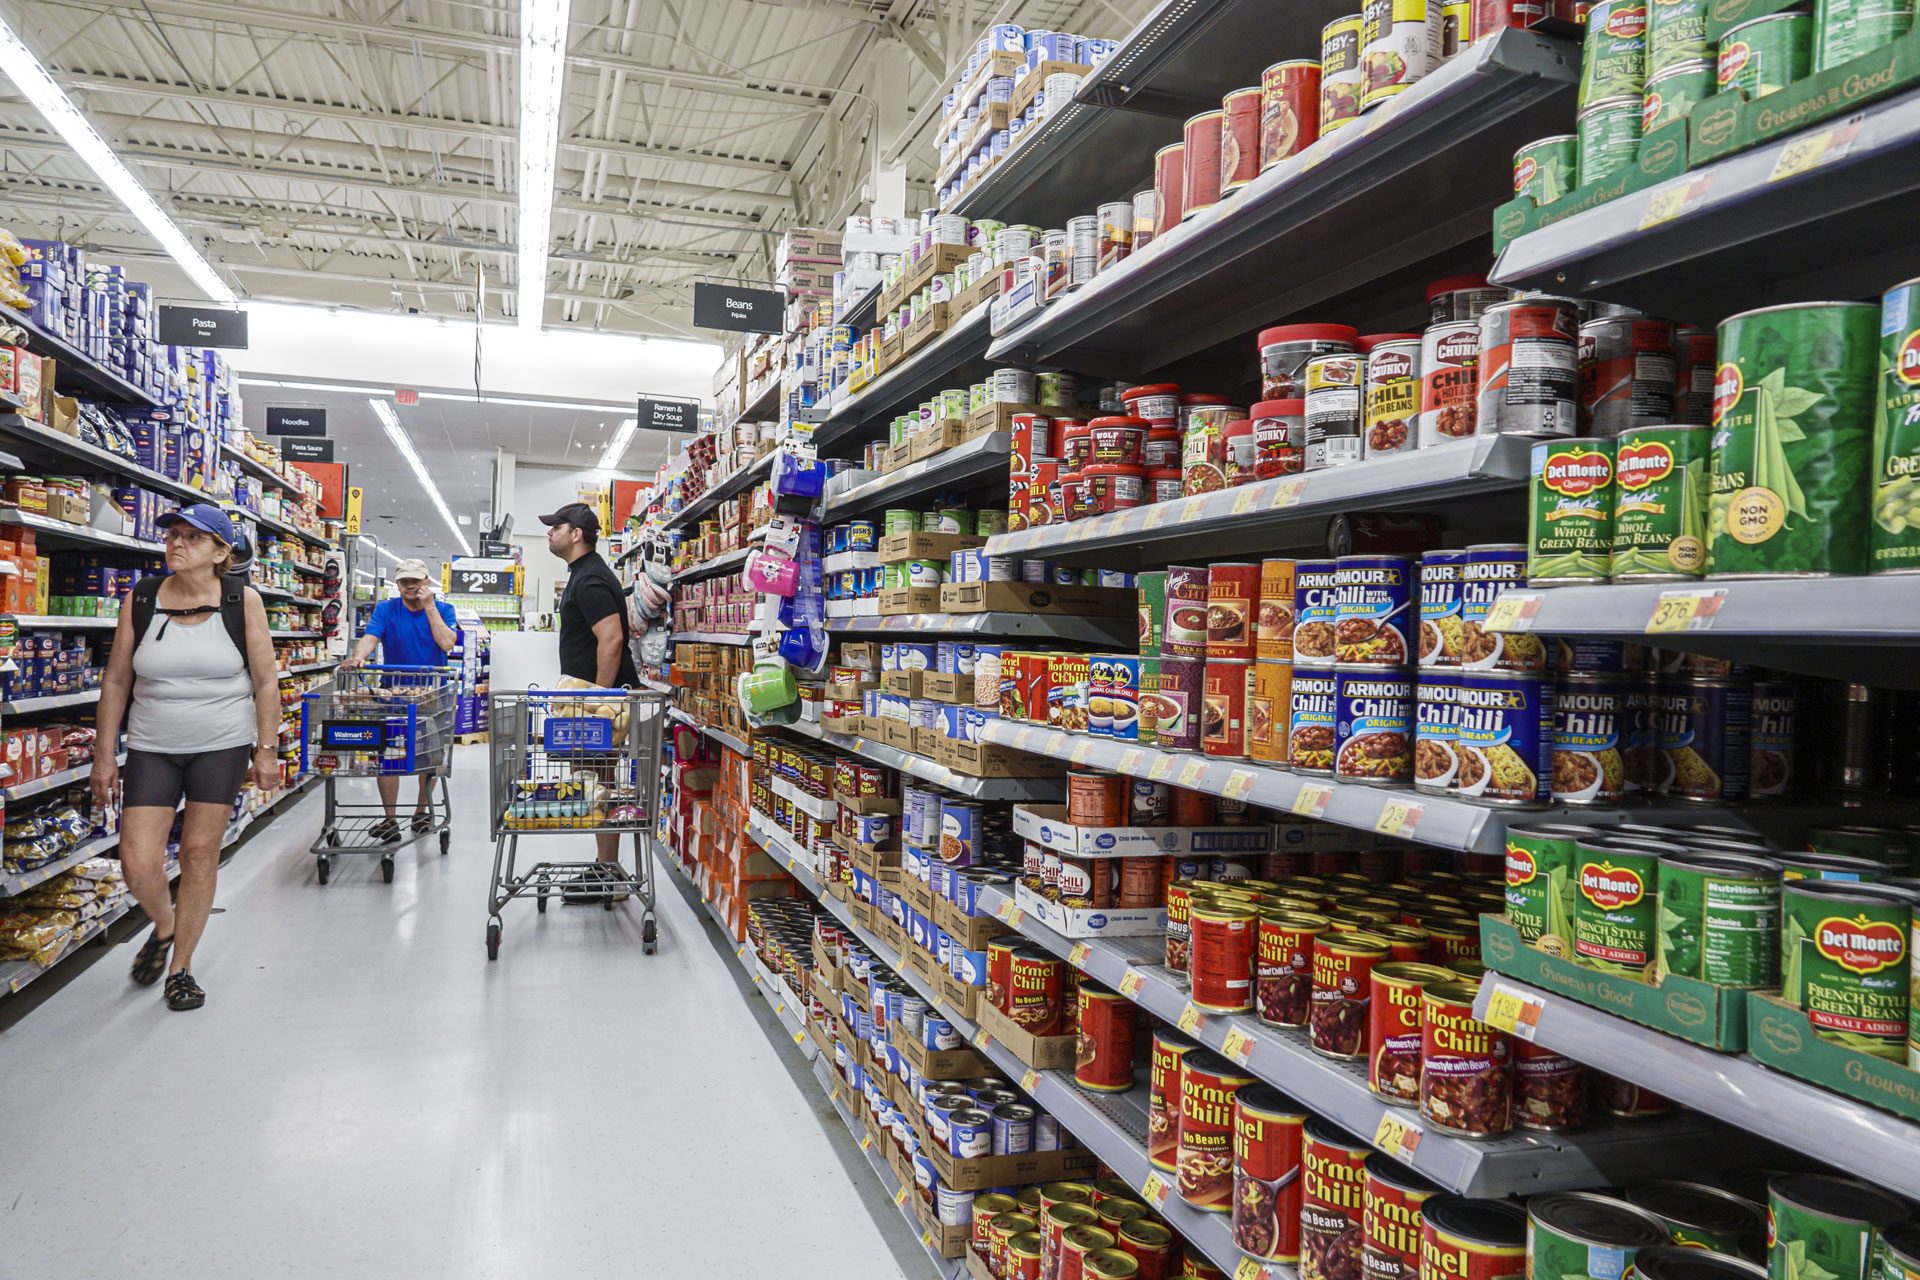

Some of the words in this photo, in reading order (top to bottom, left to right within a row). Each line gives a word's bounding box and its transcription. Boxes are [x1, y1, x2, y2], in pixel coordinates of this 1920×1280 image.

[1626, 15, 1647, 26] Mon
[1596, 57, 1632, 69] FRENCH
[1596, 67, 1626, 79] GREEN
[1626, 62, 1646, 74] BEA
[1757, 95, 1827, 131] Growers
[1843, 56, 1897, 98] Good
[1592, 180, 1626, 206] Good
[726, 298, 753, 310] Beans
[192, 318, 216, 328] Pasta
[1372, 363, 1410, 377] CHUNKY
[1368, 384, 1413, 405] CHILI
[654, 404, 676, 412] Ramen
[1386, 400, 1413, 412] BEANS
[282, 418, 310, 426] Noodles
[654, 412, 664, 420] Dry
[666, 413, 682, 422] Soup
[1096, 432, 1118, 440] WOLF
[1256, 428, 1286, 442] CHUNKY
[292, 444, 306, 452] Pasta
[306, 444, 323, 452] Sauce
[1618, 460, 1629, 473] Del
[1630, 454, 1668, 470] Monte
[1548, 465, 1566, 478] Del
[1568, 464, 1608, 478] Monte
[1563, 480, 1590, 488] Quality
[1740, 506, 1768, 515] NON
[1618, 522, 1653, 533] WHOLE
[1740, 516, 1768, 526] GMO
[349, 525, 358, 533] 15
[852, 527, 872, 536] BUSH'S
[1554, 526, 1596, 538] WHOLE
[1539, 538, 1574, 550] GREEN
[1576, 538, 1613, 549] BEANS
[1634, 532, 1672, 544] BEANS
[1168, 572, 1190, 590] Amy's
[1298, 574, 1336, 587] ARMO
[1366, 596, 1392, 604] BEANS
[1422, 584, 1454, 603] hili
[1340, 605, 1376, 614] ORIGINAL
[1292, 680, 1334, 693] ARMOU
[1346, 683, 1411, 697] ARMOUR
[1292, 694, 1327, 712] Chili
[1350, 698, 1398, 717] Chili
[1300, 714, 1333, 722] ORIGINA
[1366, 718, 1407, 727] ORIGINAL
[1463, 708, 1504, 731] hili
[1554, 712, 1614, 735] Chili
[1430, 726, 1460, 734] BEANS
[1467, 731, 1496, 741] BEANS
[1572, 736, 1608, 744] BEANS
[1059, 874, 1084, 888] CHILI
[1583, 873, 1598, 888] Del
[1600, 877, 1639, 894] Monte
[1520, 887, 1545, 898] WITH
[1708, 883, 1760, 894] Nutrition
[1594, 892, 1619, 903] Quality
[1515, 912, 1542, 926] STYLE
[1706, 916, 1742, 928] Calories
[1577, 917, 1610, 936] FRENCH
[1612, 926, 1646, 941] STYLE
[1544, 942, 1562, 951] NON
[1577, 930, 1605, 946] GREEN
[1606, 936, 1644, 950] BEANS
[1822, 929, 1848, 946] Del
[1850, 936, 1900, 952] Monte
[1258, 942, 1288, 963] Chili
[1578, 942, 1589, 952] NO
[1590, 944, 1606, 956] SALT
[1608, 950, 1639, 960] ADDED
[1844, 950, 1878, 964] Quality
[1014, 975, 1046, 990] Chili
[1314, 965, 1338, 987] hili
[1024, 996, 1044, 1004] Beans
[1596, 982, 1634, 1008] Good
[1808, 982, 1865, 1005] FRENCH
[1868, 990, 1910, 1007] STYLE
[1809, 998, 1858, 1015] GREEN
[1862, 1004, 1907, 1018] BEANS
[1816, 1014, 1832, 1024] NO
[1834, 1016, 1863, 1030] SALT
[1866, 1020, 1902, 1032] ADDED
[1386, 1038, 1421, 1050] Homestyle
[1434, 1028, 1489, 1054] Chili
[1454, 1060, 1470, 1071] with
[1470, 1060, 1490, 1070] Beans
[1181, 1094, 1230, 1126] Chili
[1184, 1132, 1194, 1144] No
[1200, 1133, 1226, 1146] Beans
[1304, 1171, 1361, 1208] Chili
[1313, 1210, 1344, 1229] Beans
[1364, 1208, 1418, 1254] Chili
[1370, 1254, 1400, 1275] Beans
